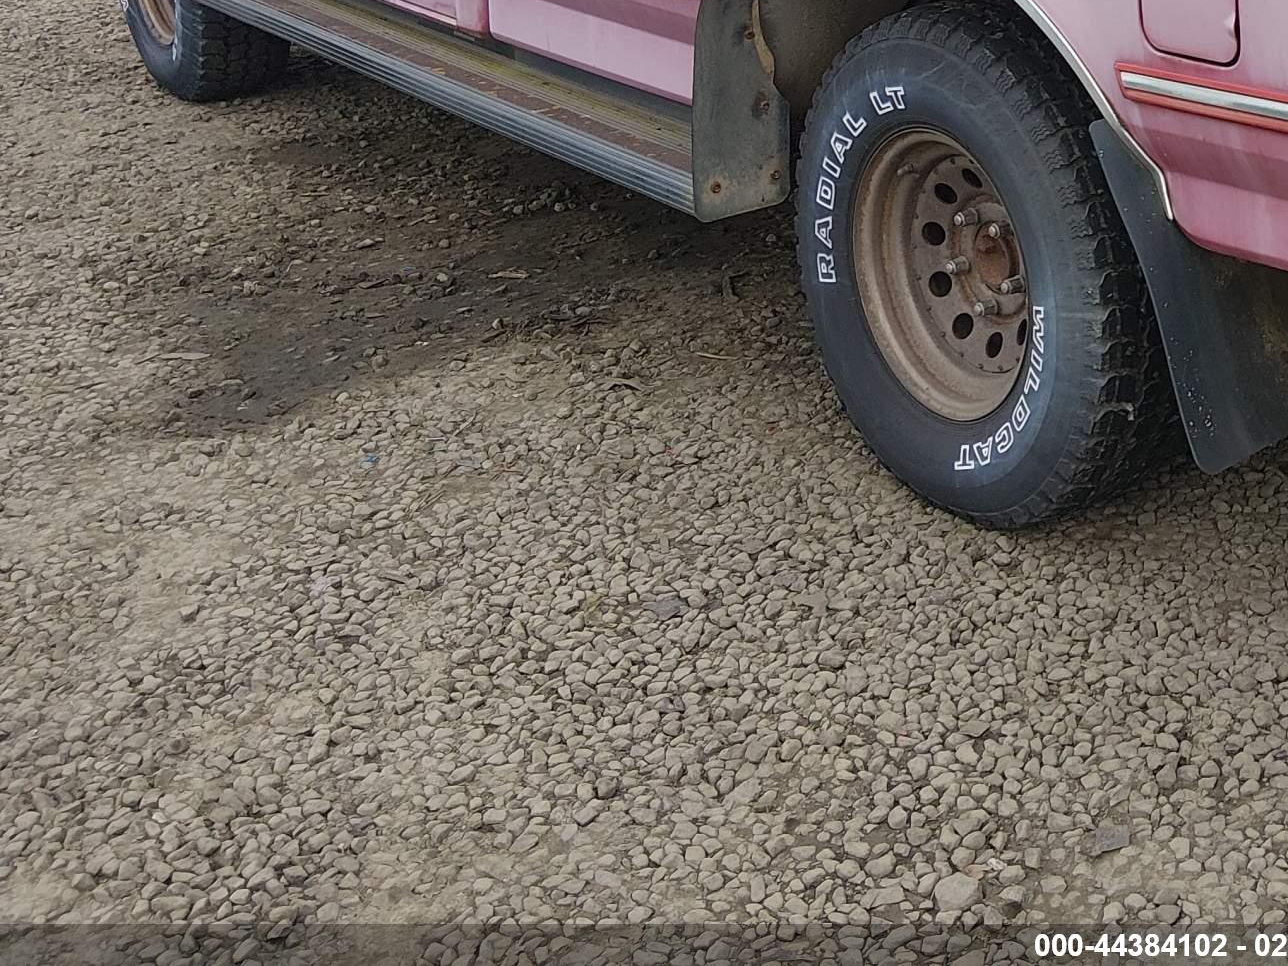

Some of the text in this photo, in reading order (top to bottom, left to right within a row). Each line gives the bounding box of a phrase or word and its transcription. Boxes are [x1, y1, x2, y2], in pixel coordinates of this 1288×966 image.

[814, 86, 907, 283] RADIAL LT
[954, 305, 1045, 471] WILDCAT
